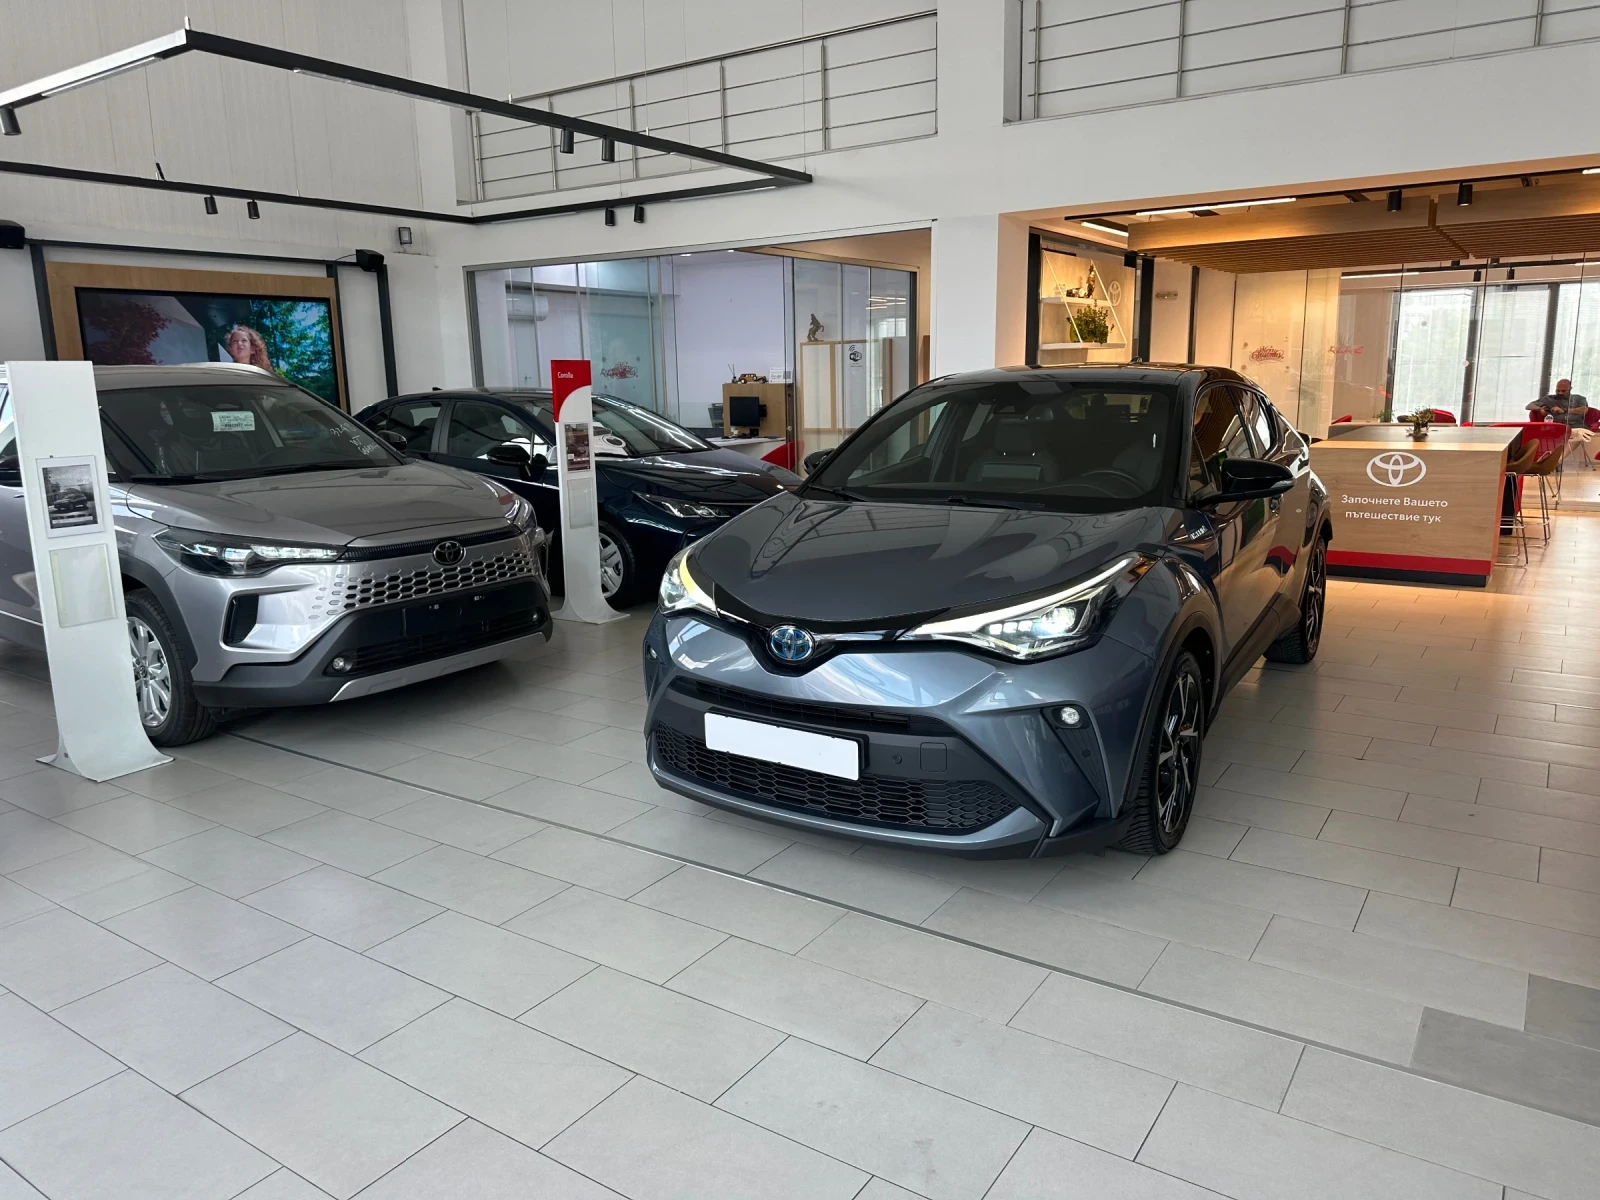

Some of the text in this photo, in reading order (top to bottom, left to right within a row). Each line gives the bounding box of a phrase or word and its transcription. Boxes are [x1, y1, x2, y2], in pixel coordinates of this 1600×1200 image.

[557, 371, 574, 379] Corolla
[1341, 494, 1448, 508] Започнете Вашето
[1345, 511, 1442, 524] пътешествие тук
